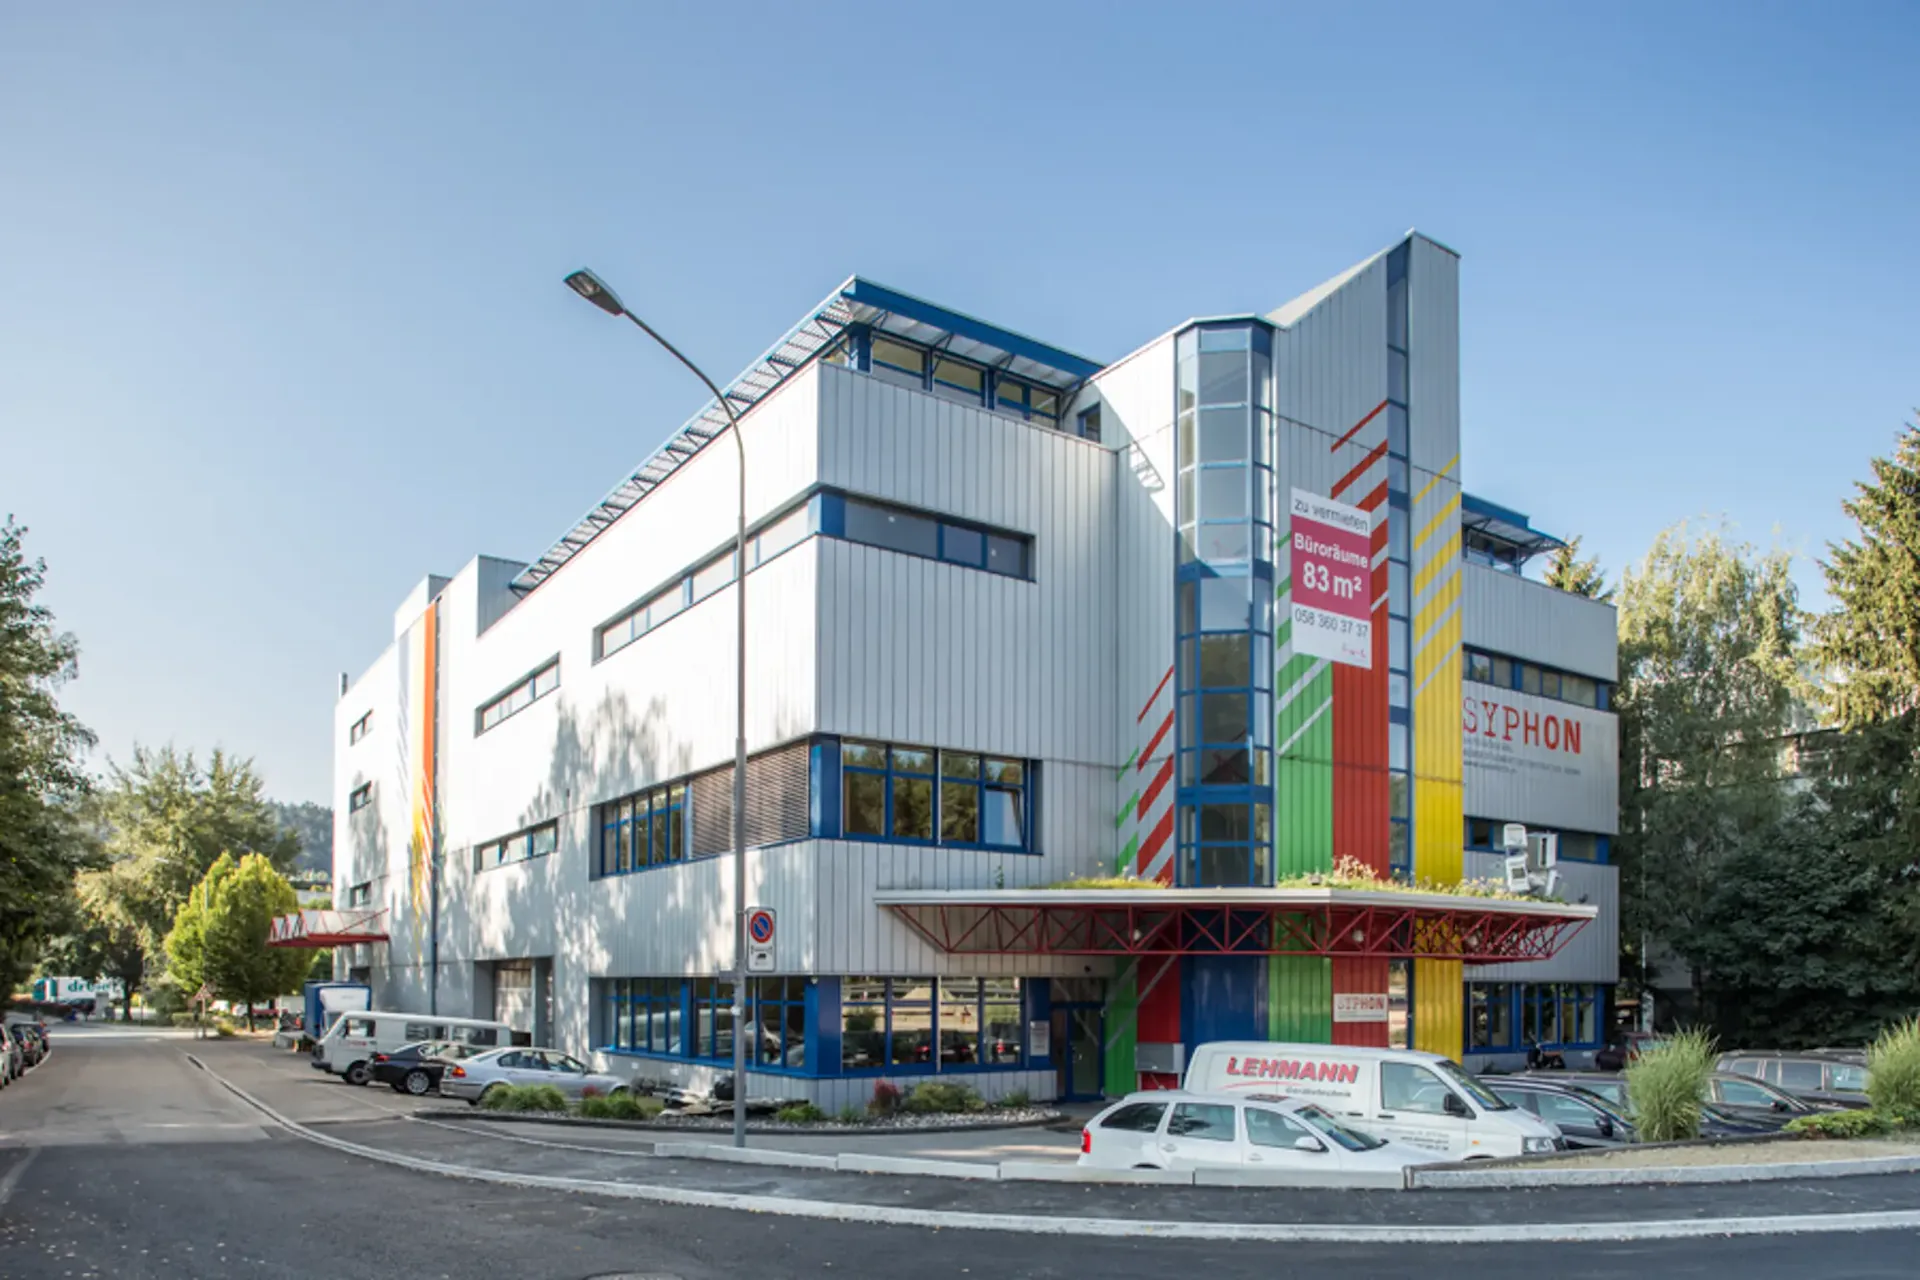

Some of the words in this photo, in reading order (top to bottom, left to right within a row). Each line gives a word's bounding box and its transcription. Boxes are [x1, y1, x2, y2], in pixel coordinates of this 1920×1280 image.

[1312, 504, 1369, 532] vermieten
[1294, 532, 1369, 569] Büroräume
[1303, 561, 1329, 592] 83
[1333, 575, 1362, 600] m²
[1294, 607, 1315, 627] 058
[1318, 613, 1338, 632] 360
[1340, 618, 1354, 635] 37
[1356, 622, 1369, 638] 37
[1463, 697, 1581, 755] SYPHON
[1226, 1056, 1360, 1084] LEHMANN
